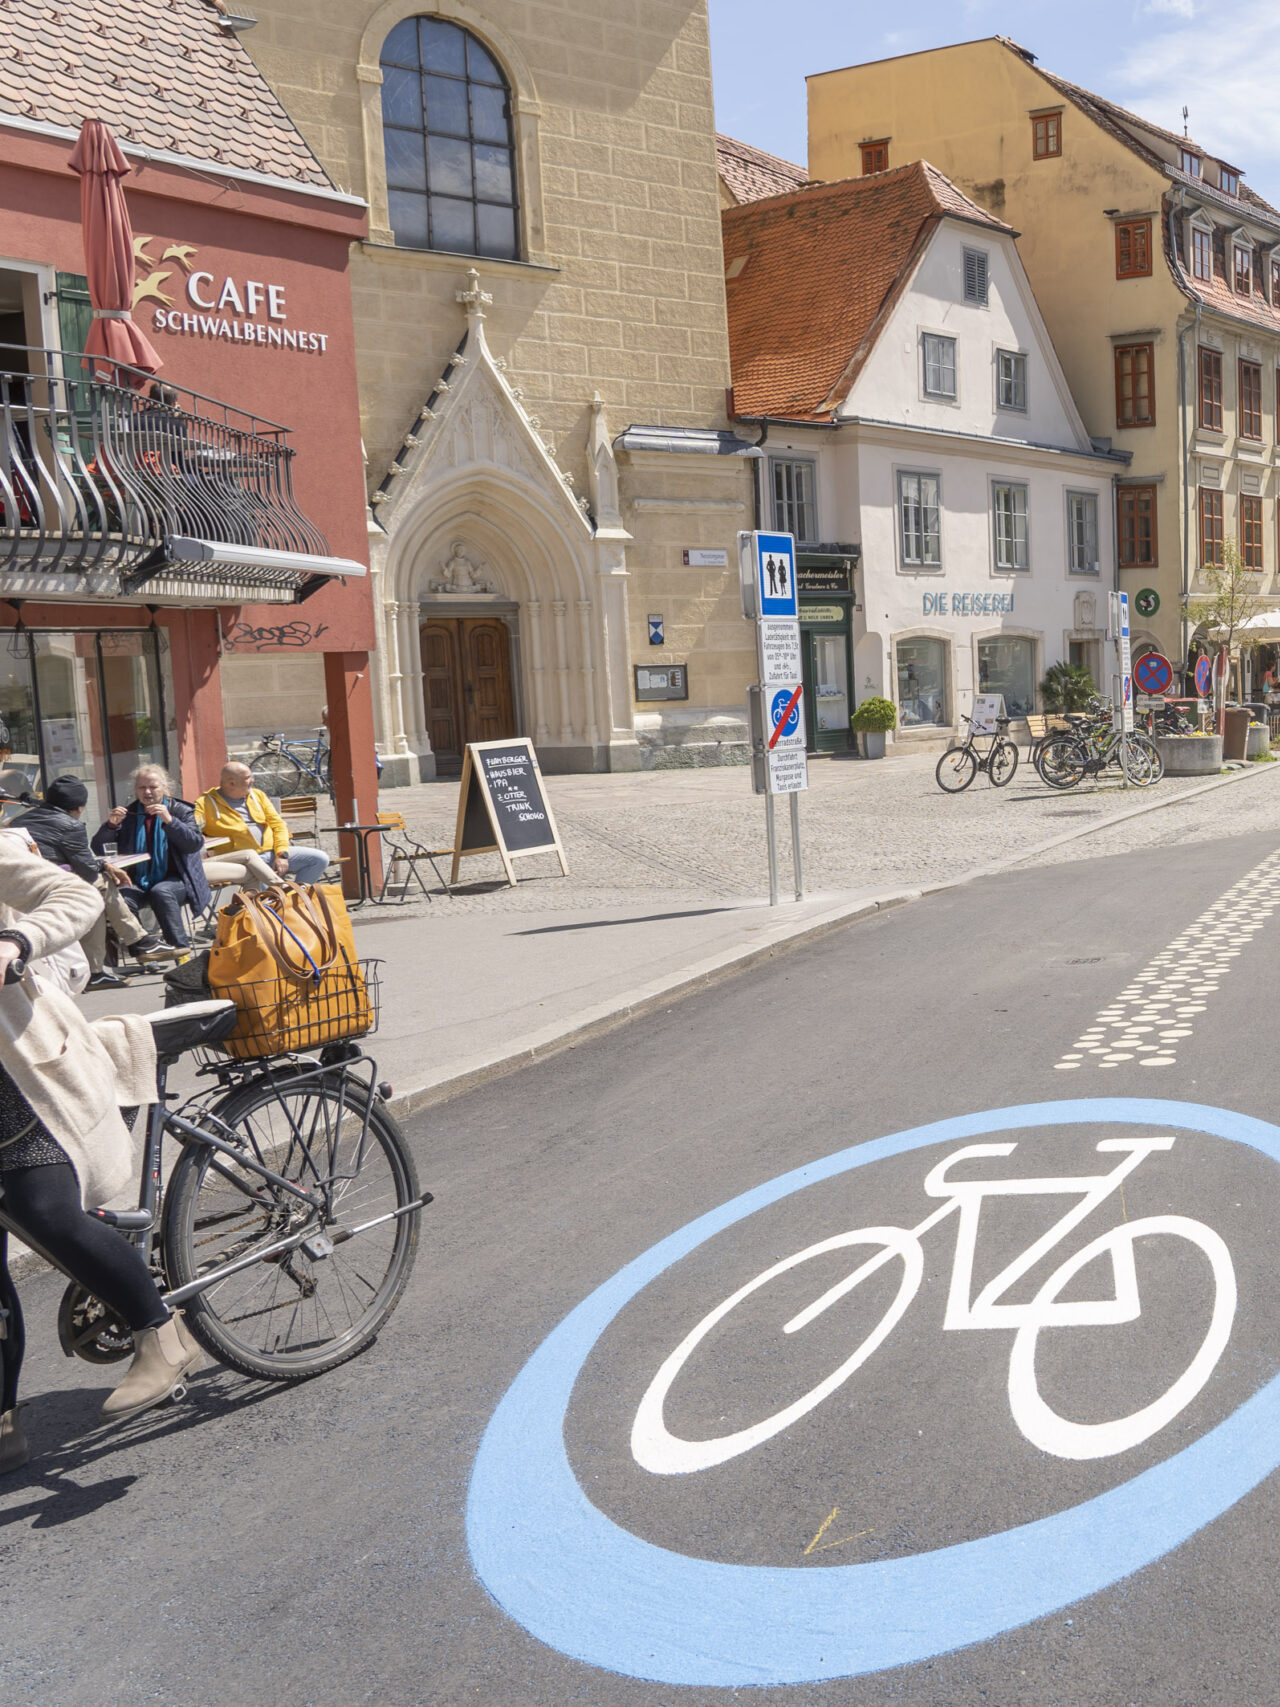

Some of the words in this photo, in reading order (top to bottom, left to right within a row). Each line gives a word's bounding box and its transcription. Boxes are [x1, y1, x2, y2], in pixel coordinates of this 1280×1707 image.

[187, 271, 287, 320] CAFE
[155, 308, 329, 352] SCHWALBENNEST
[923, 592, 949, 612] DIE
[952, 592, 1014, 612] REISEREI
[489, 767, 527, 778] HAUSBIER
[493, 779, 508, 788] IPA
[505, 801, 532, 812] TRINK
